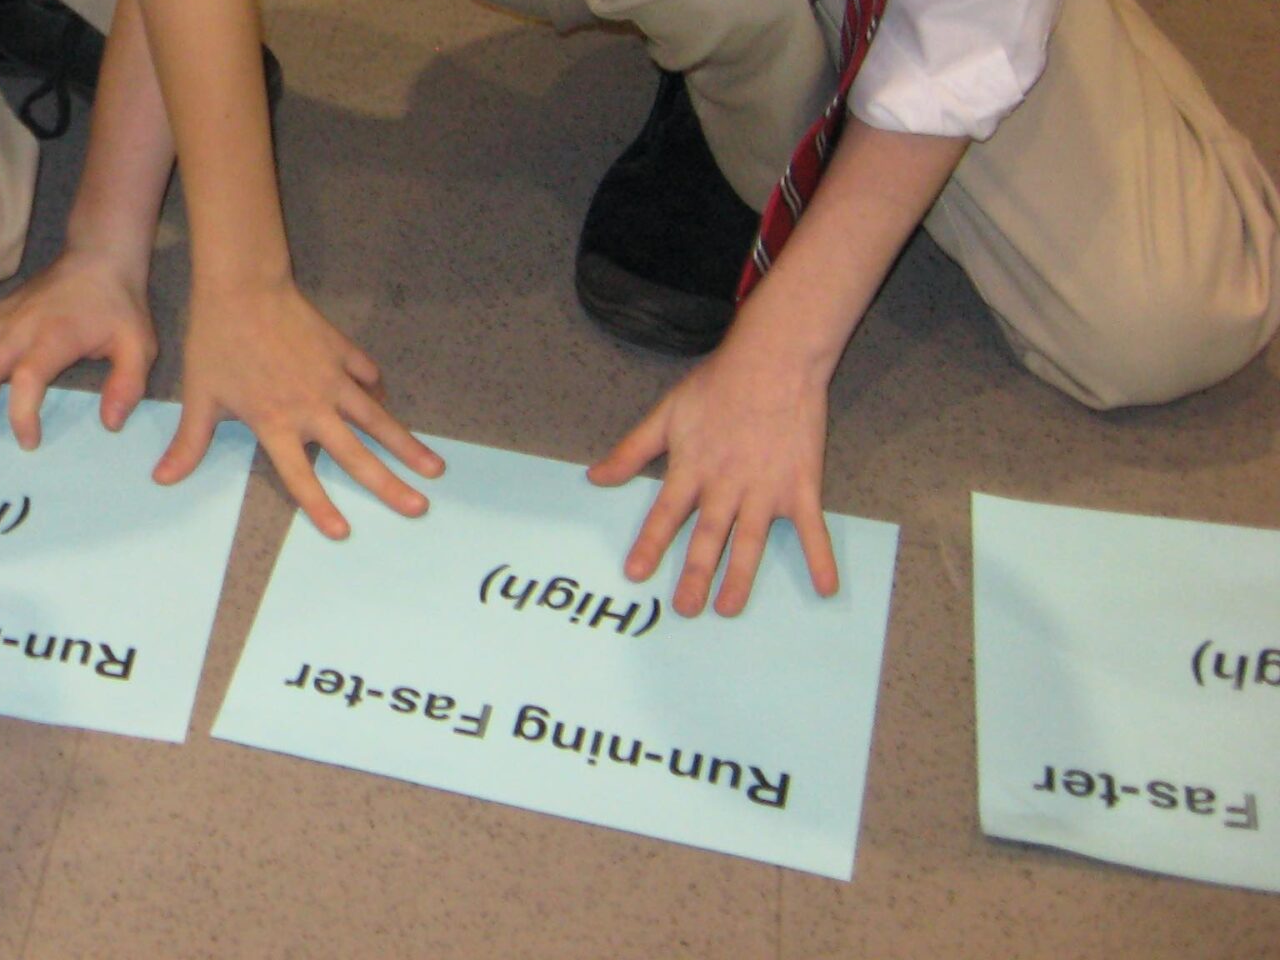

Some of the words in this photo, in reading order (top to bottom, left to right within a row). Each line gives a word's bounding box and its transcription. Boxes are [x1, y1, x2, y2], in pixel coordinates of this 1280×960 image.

[479, 563, 662, 638] (High)
[285, 662, 493, 739] Fas-ter
[512, 704, 790, 809] Run-ning
[1033, 765, 1259, 831] Fas-ter
